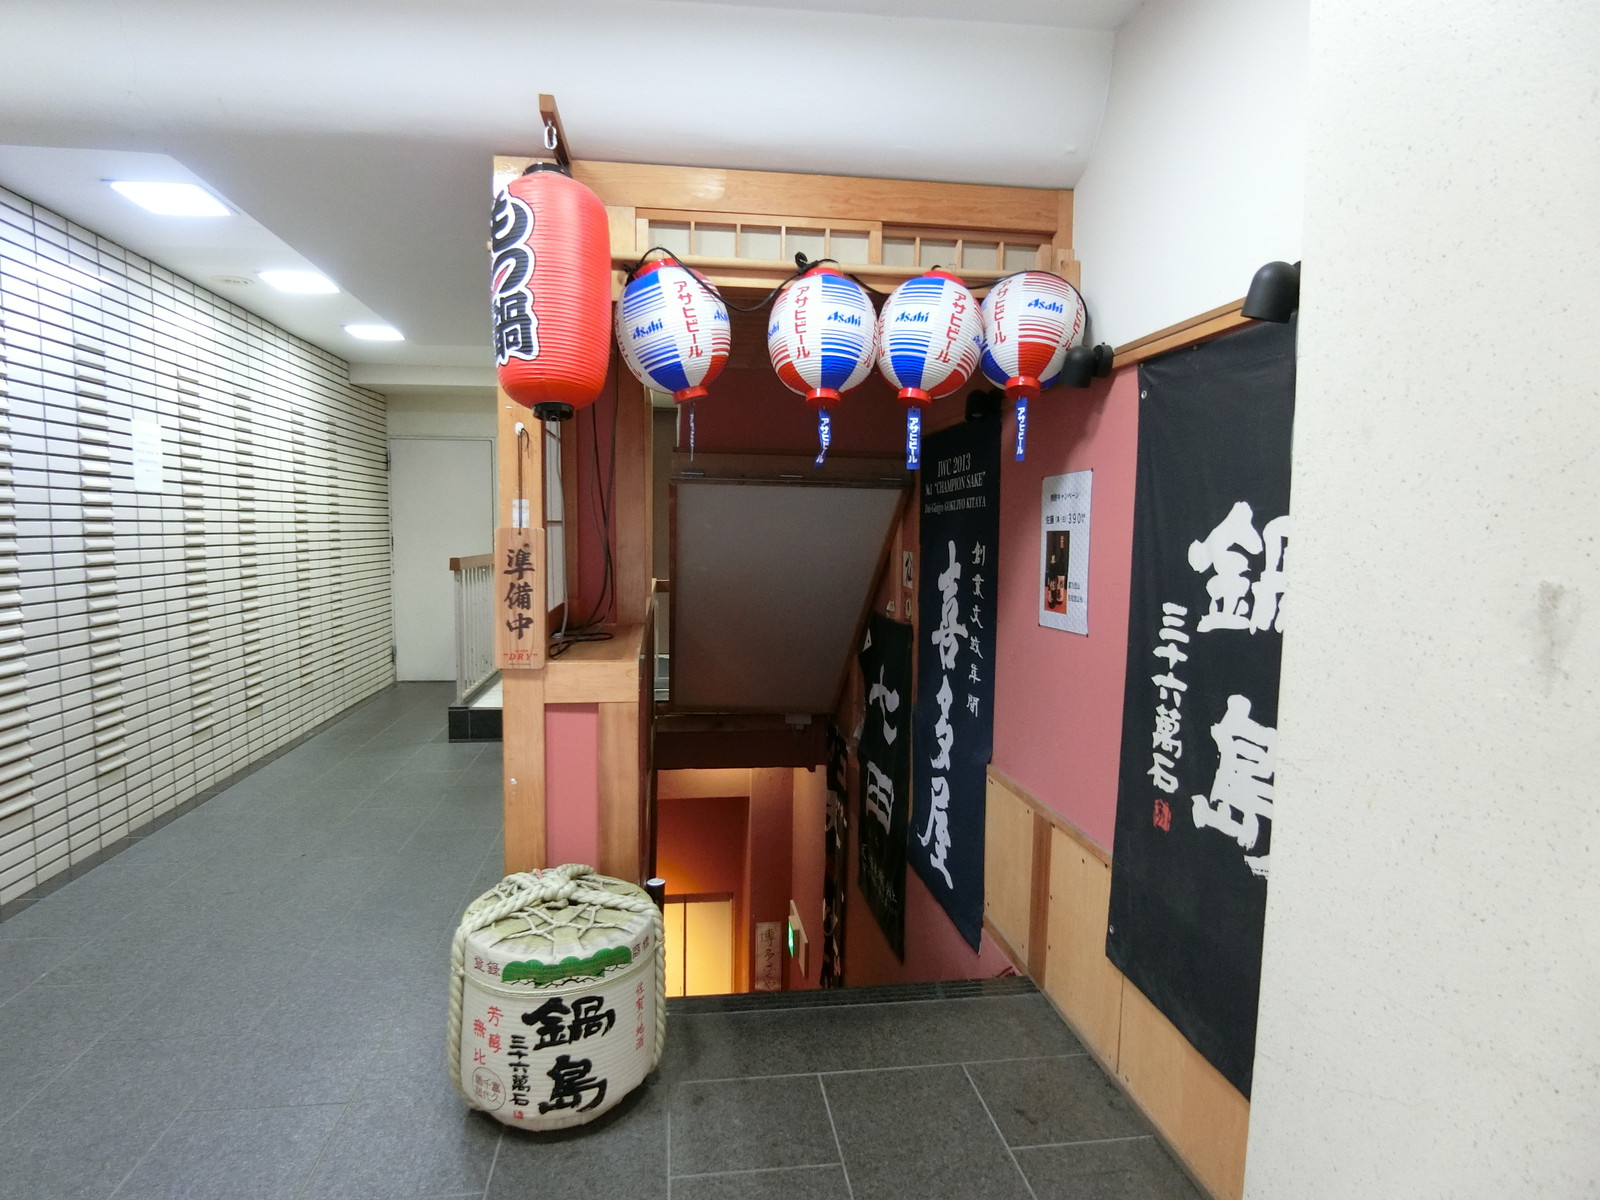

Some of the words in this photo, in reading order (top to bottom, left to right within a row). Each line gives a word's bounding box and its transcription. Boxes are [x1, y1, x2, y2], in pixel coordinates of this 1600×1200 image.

[632, 317, 664, 339] Asahi
[673, 281, 703, 358] アサヒビール
[794, 286, 811, 359] アサヒビール
[827, 310, 862, 327] Asahi
[895, 311, 929, 323] Asahi
[935, 291, 967, 363] アサヒビール
[994, 280, 1013, 345] アサヒビール
[1028, 298, 1064, 314] Asahi
[907, 417, 919, 464] アサヒビール
[937, 459, 952, 478] IWC
[953, 452, 971, 474] 2013
[1050, 492, 1080, 502] キャンペーン
[503, 548, 535, 640] 準備中
[1147, 601, 1190, 794] 三十六萬石
[473, 1018, 487, 1066] 無比
[487, 1005, 504, 1054] 芳醇
[634, 983, 645, 1051] 佐賀の地酒
[507, 1034, 531, 1107] 三十六萬石
[521, 995, 616, 1115] 鍋島
